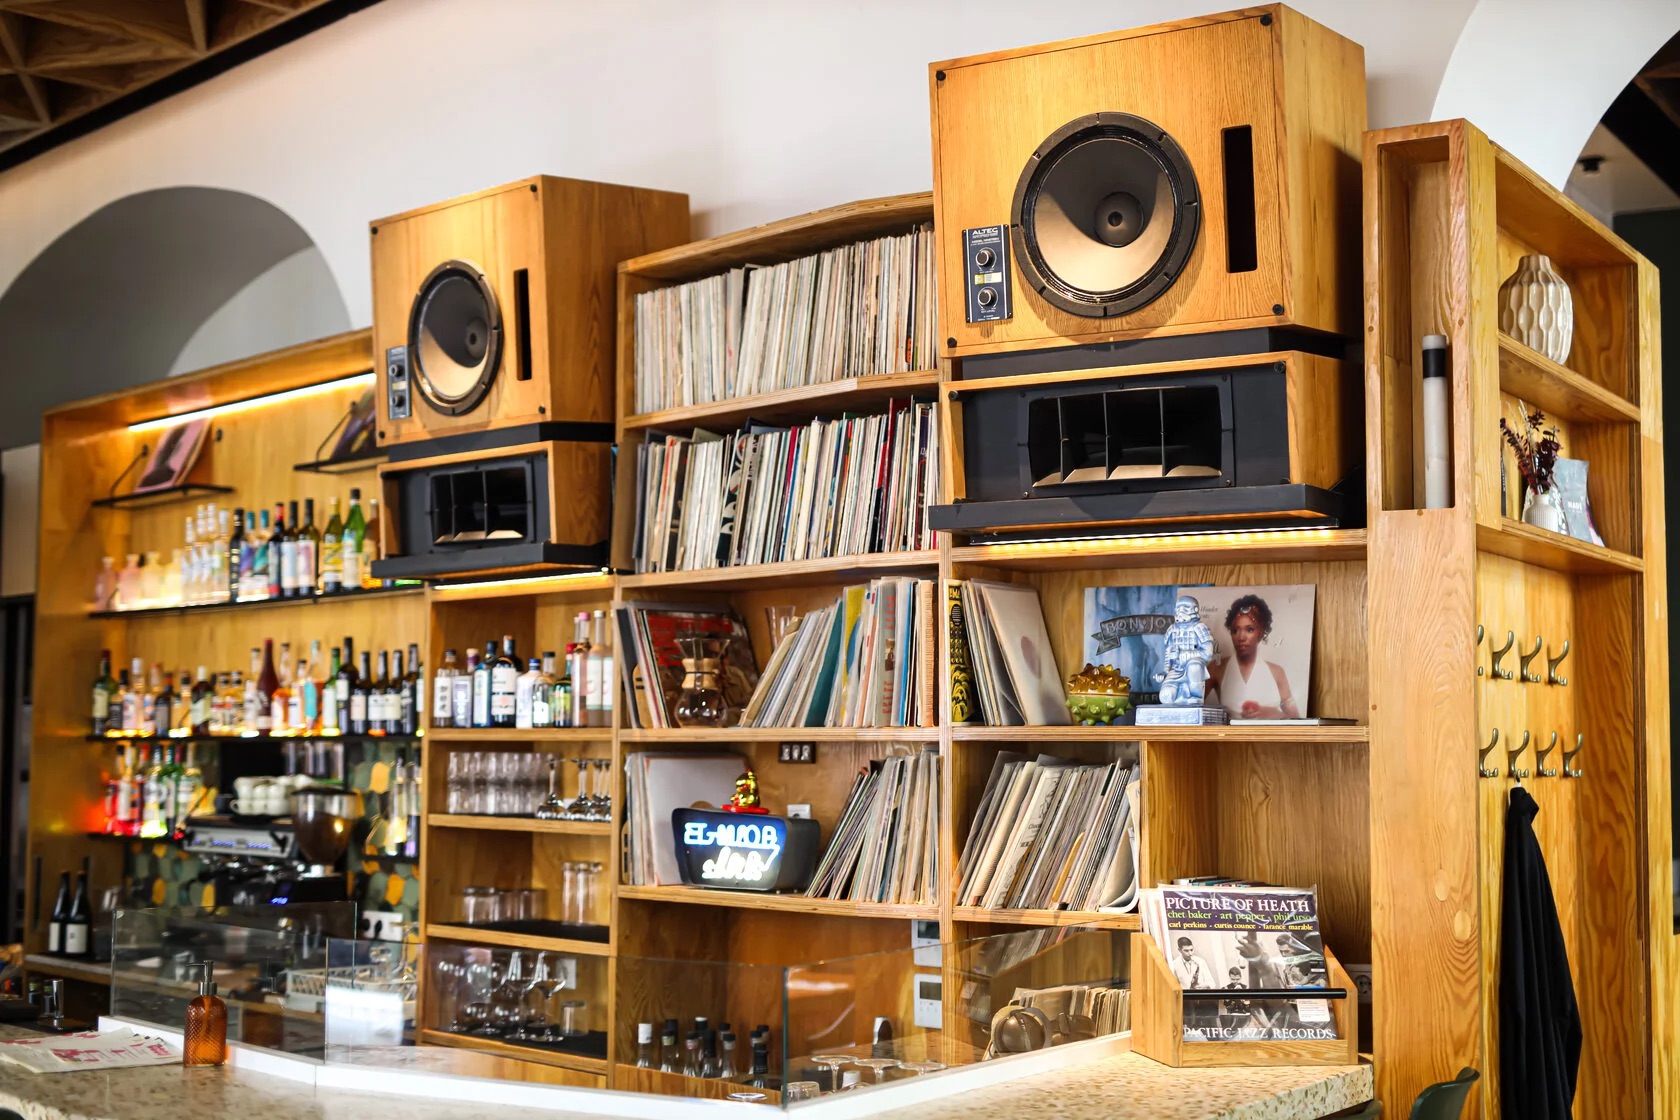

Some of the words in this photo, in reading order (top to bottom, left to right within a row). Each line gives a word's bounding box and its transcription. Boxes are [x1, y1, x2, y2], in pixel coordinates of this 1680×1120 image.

[972, 227, 999, 235] ALTEC
[1105, 618, 1139, 633] BON
[1165, 897, 1233, 910] PICTURE
[1234, 898, 1254, 911] OF
[1257, 899, 1310, 912] HEATH
[1167, 909, 1186, 919] chet
[1187, 910, 1212, 919] baker
[1220, 911, 1232, 919] art
[1236, 912, 1265, 922] pepper
[1273, 912, 1291, 922] phil
[1183, 921, 1207, 929] perkins
[1214, 921, 1232, 929] curtis
[1288, 923, 1314, 931] marable
[1183, 1027, 1233, 1038] PACIFIC
[1237, 1027, 1268, 1039] JAZZ
[1272, 1027, 1333, 1039] RECORDS
